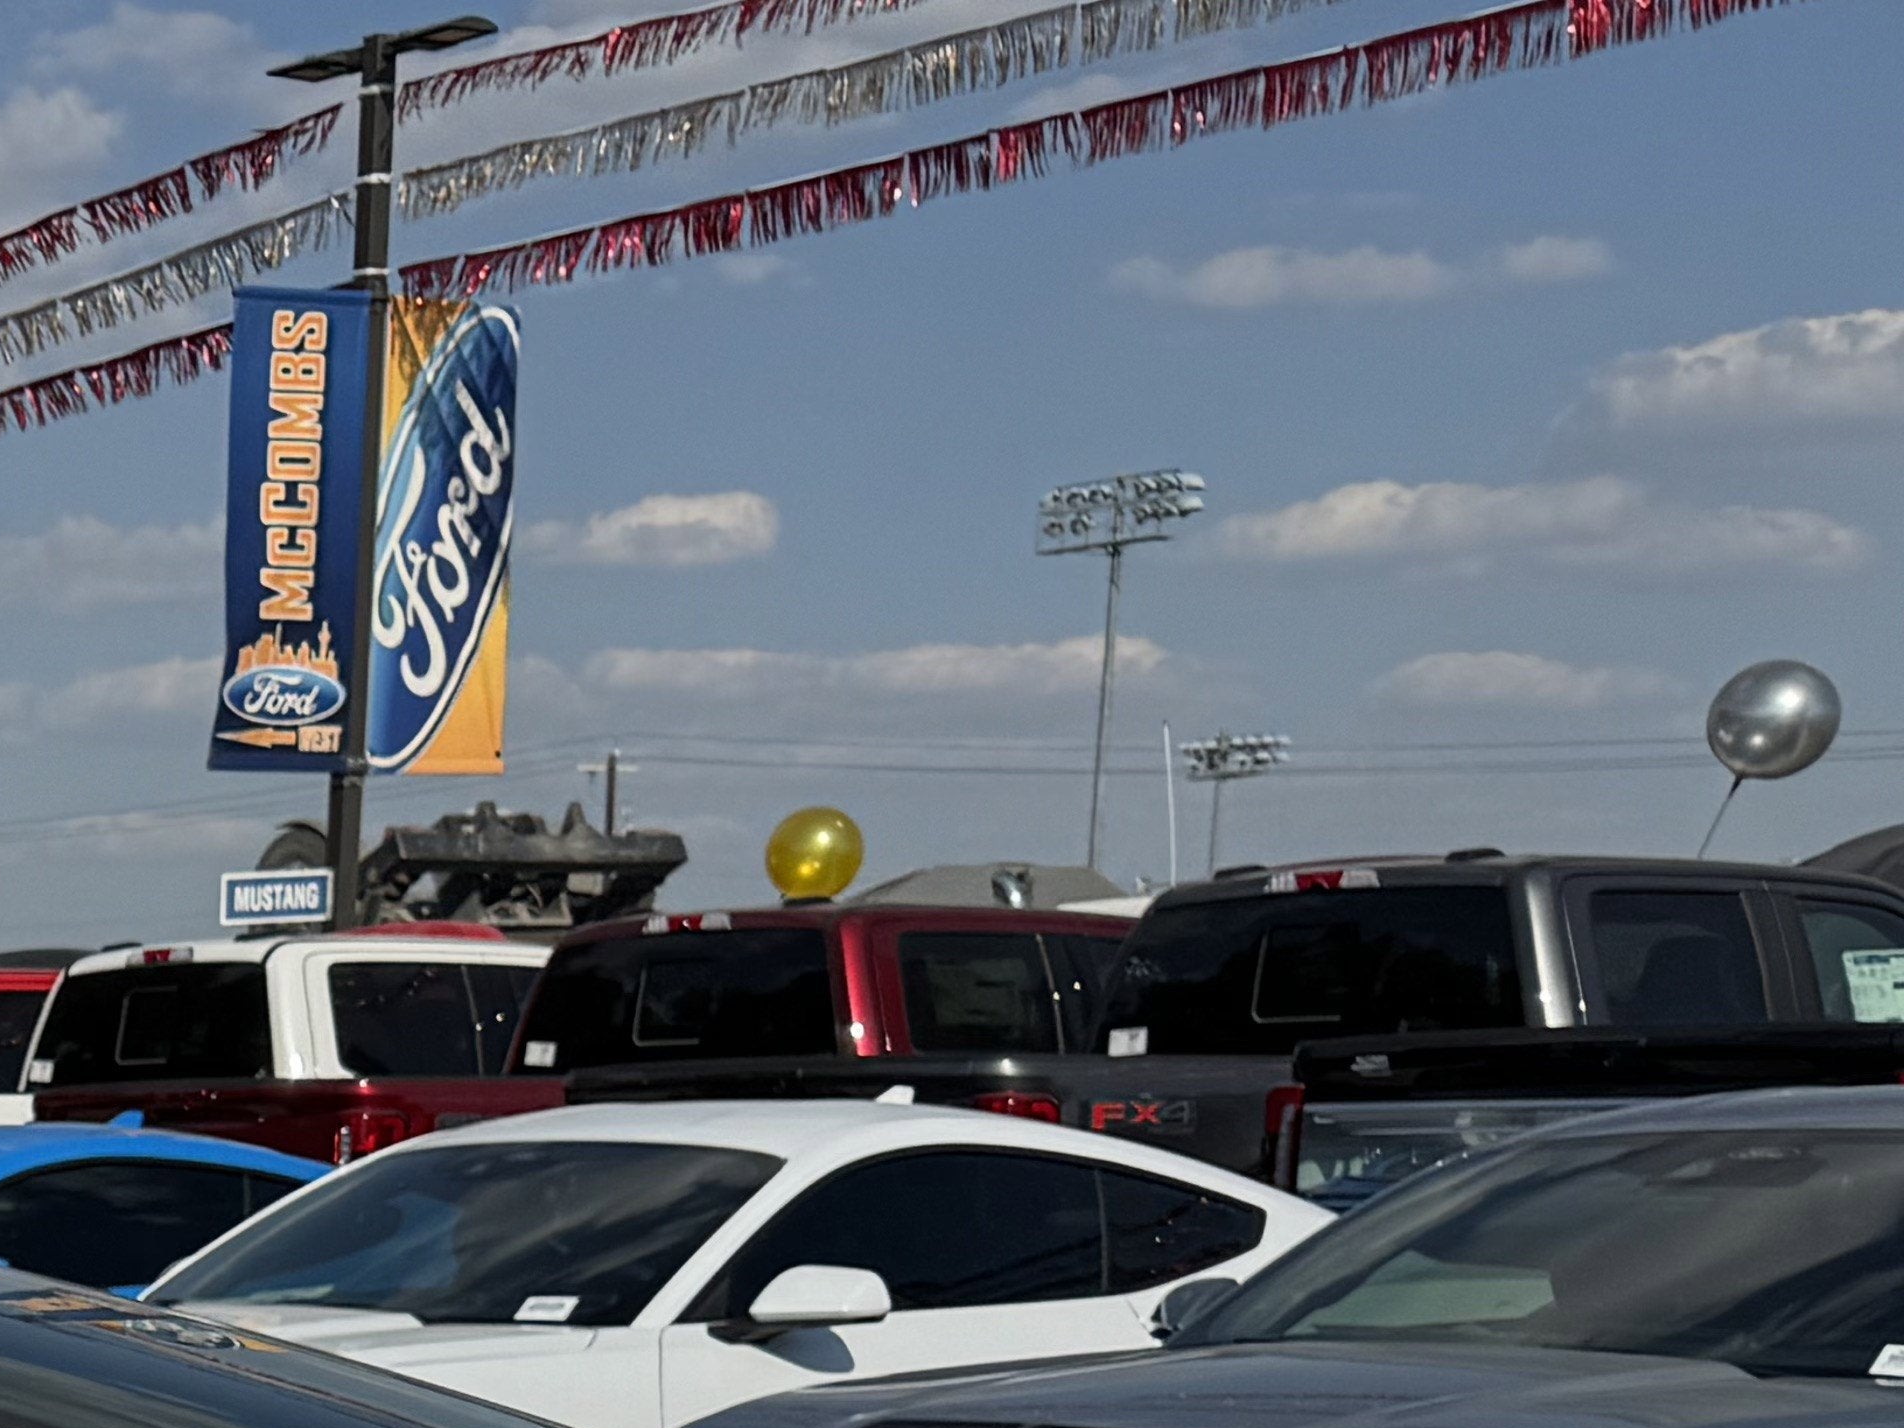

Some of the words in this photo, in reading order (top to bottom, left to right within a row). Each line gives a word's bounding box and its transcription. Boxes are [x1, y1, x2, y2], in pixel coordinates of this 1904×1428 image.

[259, 309, 329, 622] MCCOMBS
[372, 379, 513, 698] Ford
[243, 672, 321, 716] Ford
[233, 883, 320, 915] MUSTANG
[1091, 1099, 1196, 1133] FX4
